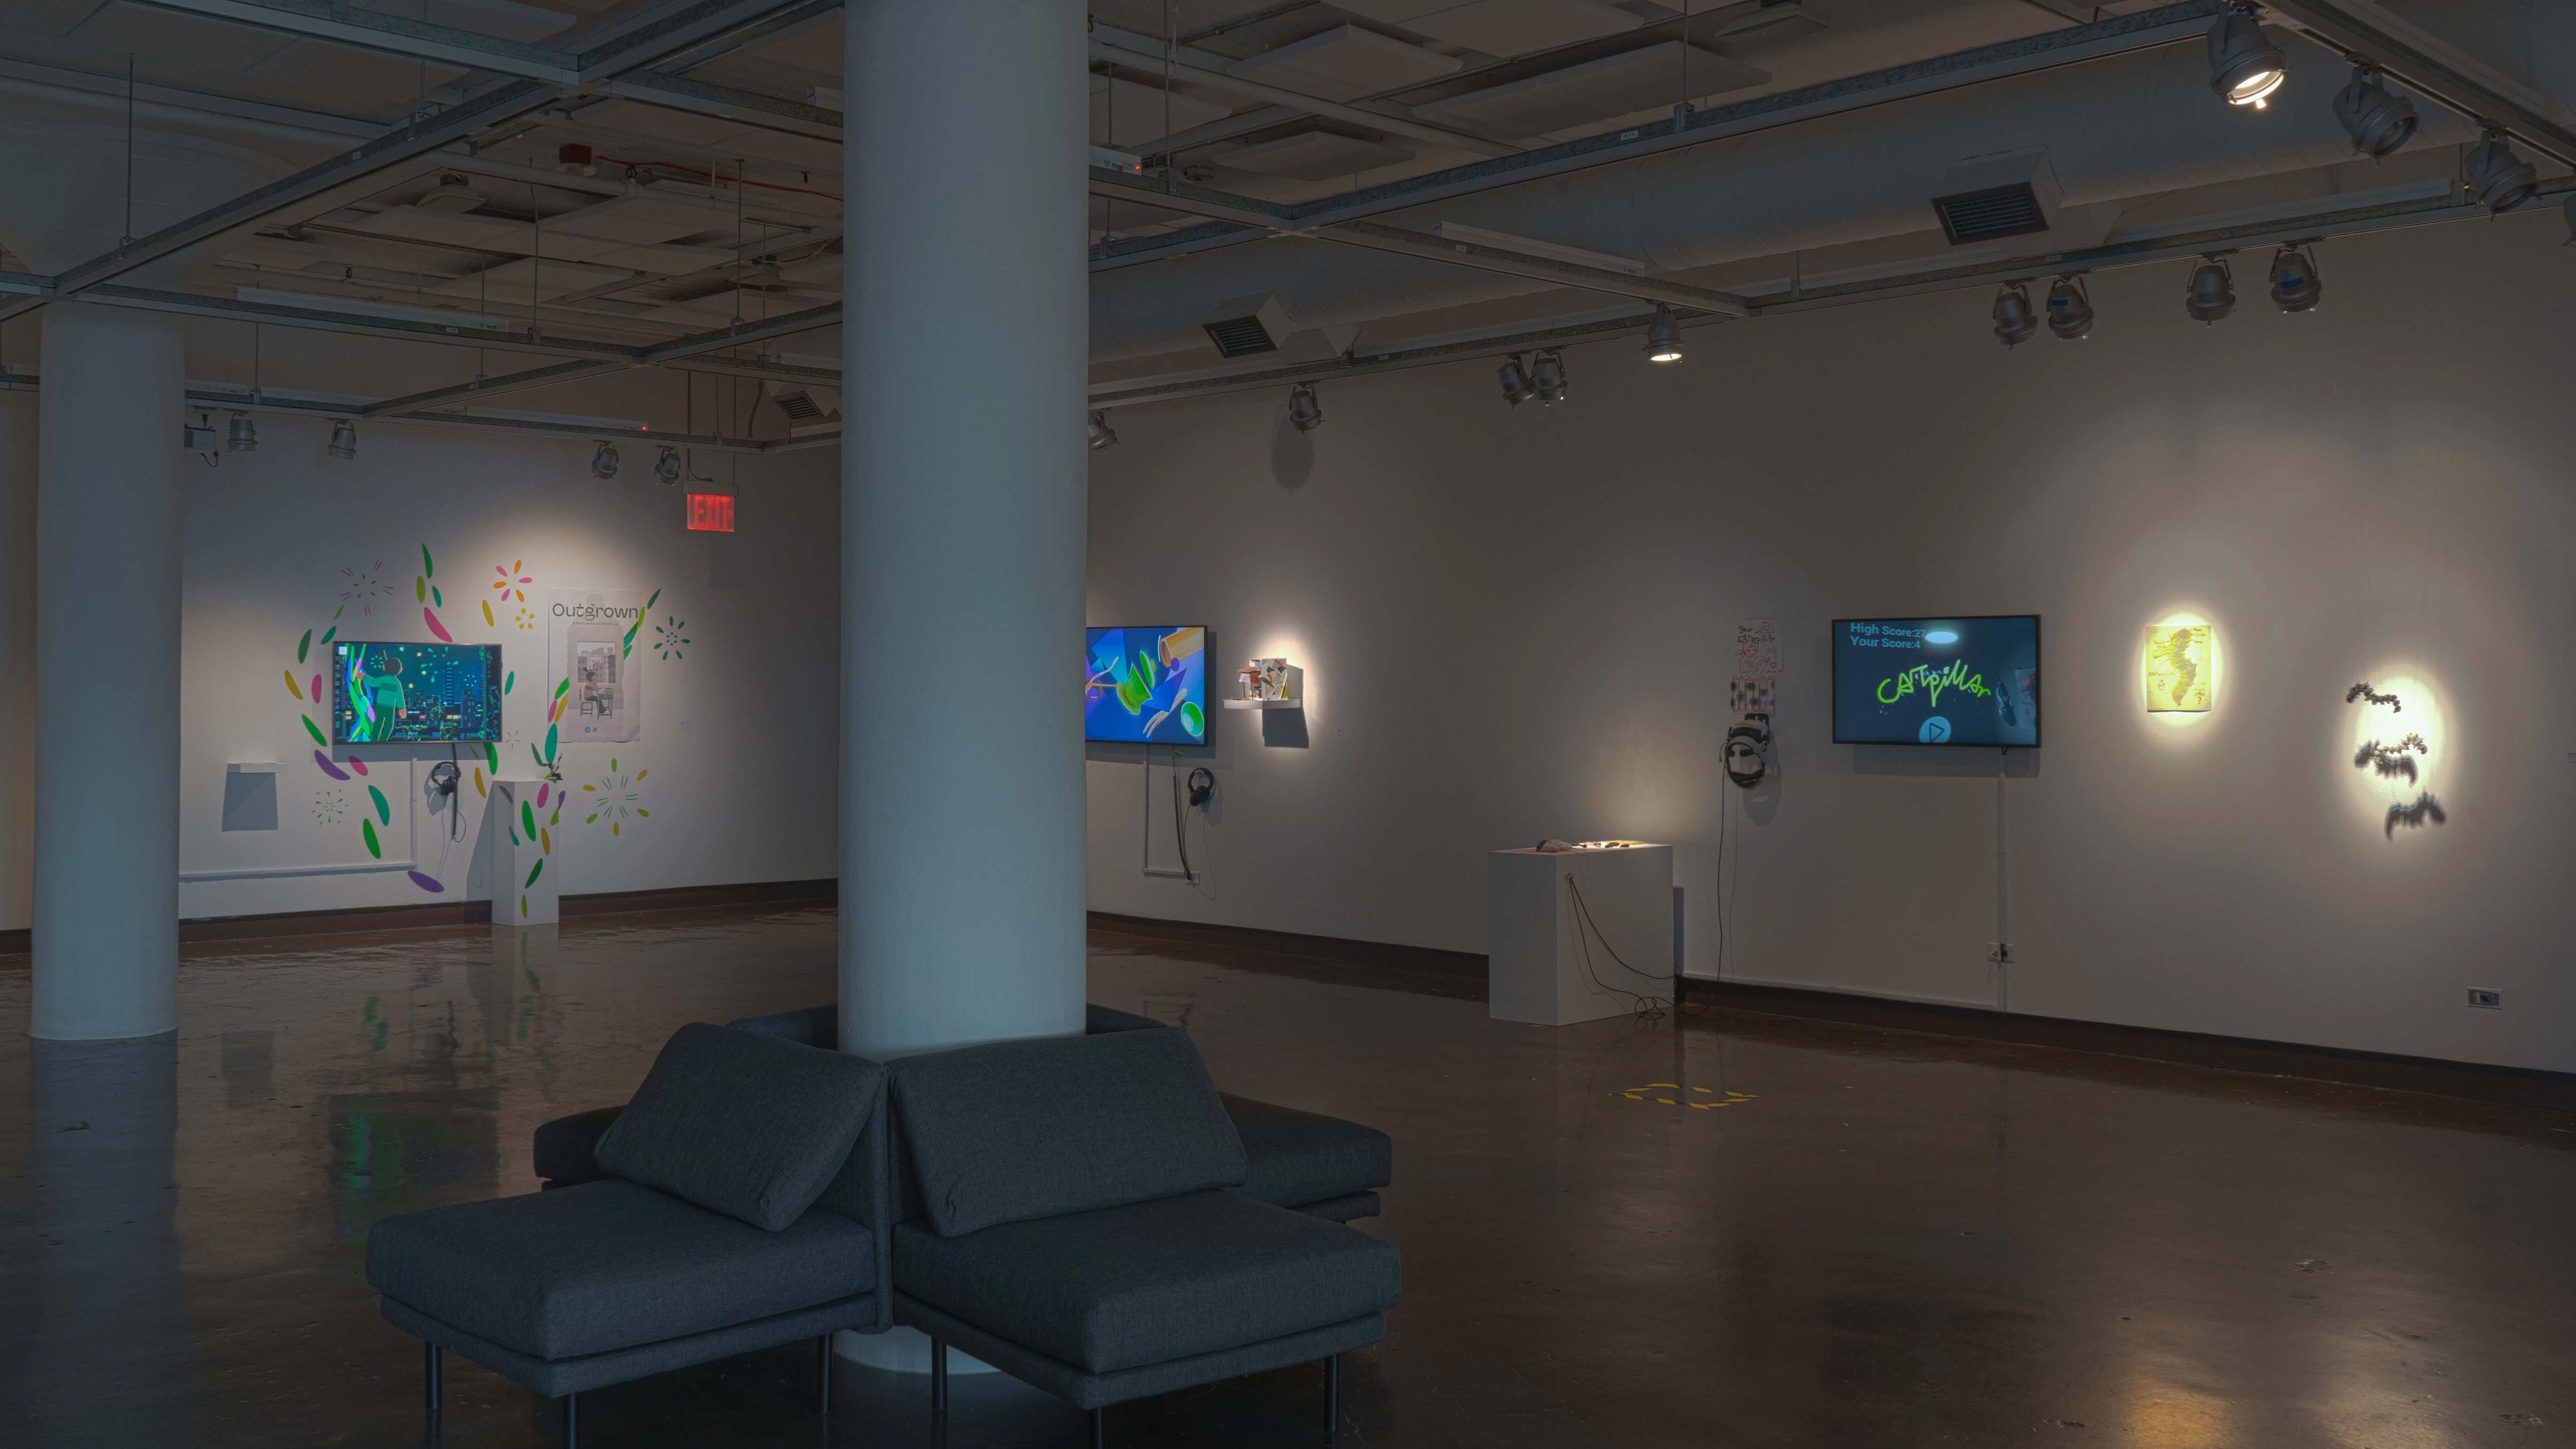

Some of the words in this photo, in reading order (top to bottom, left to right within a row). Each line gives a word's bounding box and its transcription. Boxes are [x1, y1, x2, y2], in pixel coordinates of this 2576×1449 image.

[693, 494, 731, 529] EXIT
[553, 603, 638, 621] Outgrown
[1850, 622, 1879, 636] High
[1882, 626, 1927, 638] Score:27
[1850, 635, 1879, 647] Your
[1882, 638, 1921, 649] Score:4
